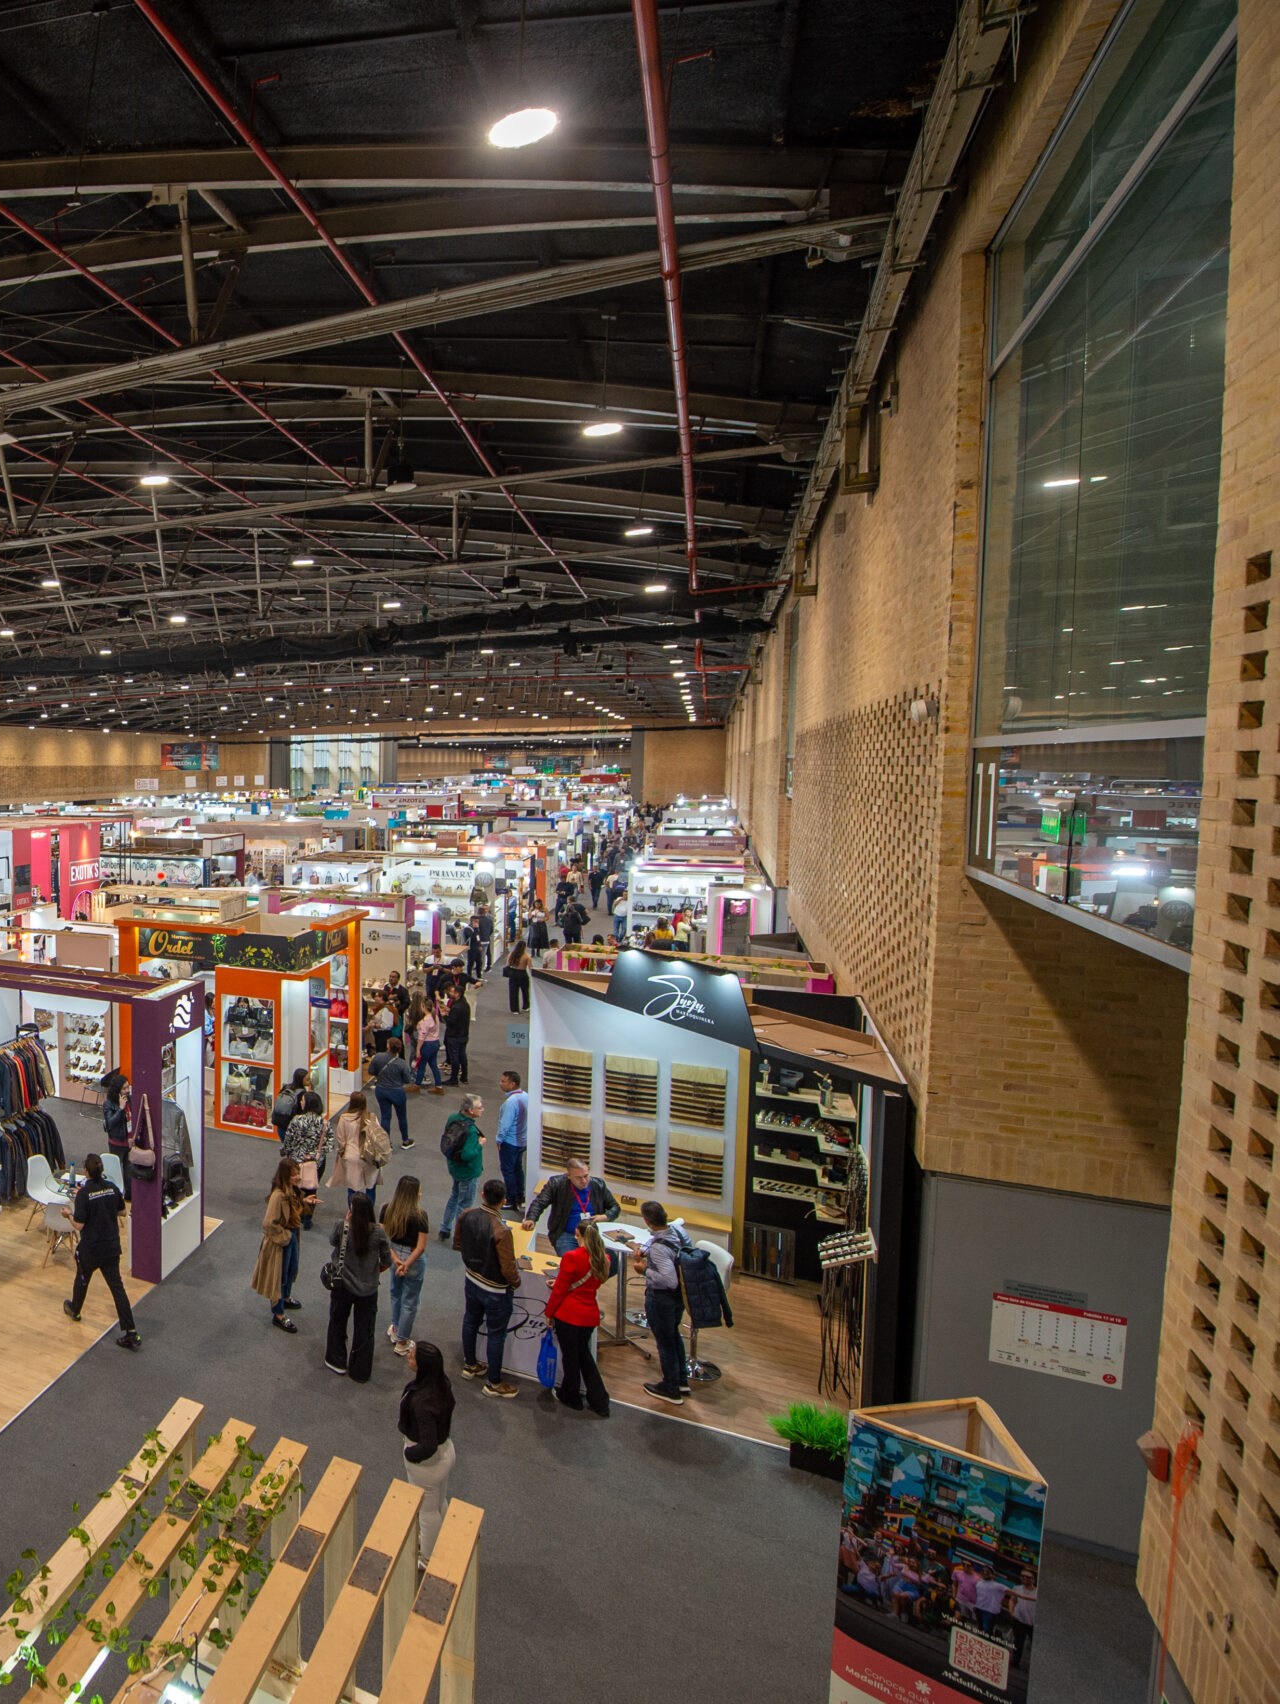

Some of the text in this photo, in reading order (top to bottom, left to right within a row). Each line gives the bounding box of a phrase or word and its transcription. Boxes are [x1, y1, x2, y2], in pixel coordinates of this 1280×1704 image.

[148, 929, 194, 956] Ordel
[511, 1031, 526, 1040] 506
[864, 1667, 906, 1694] Conoce
